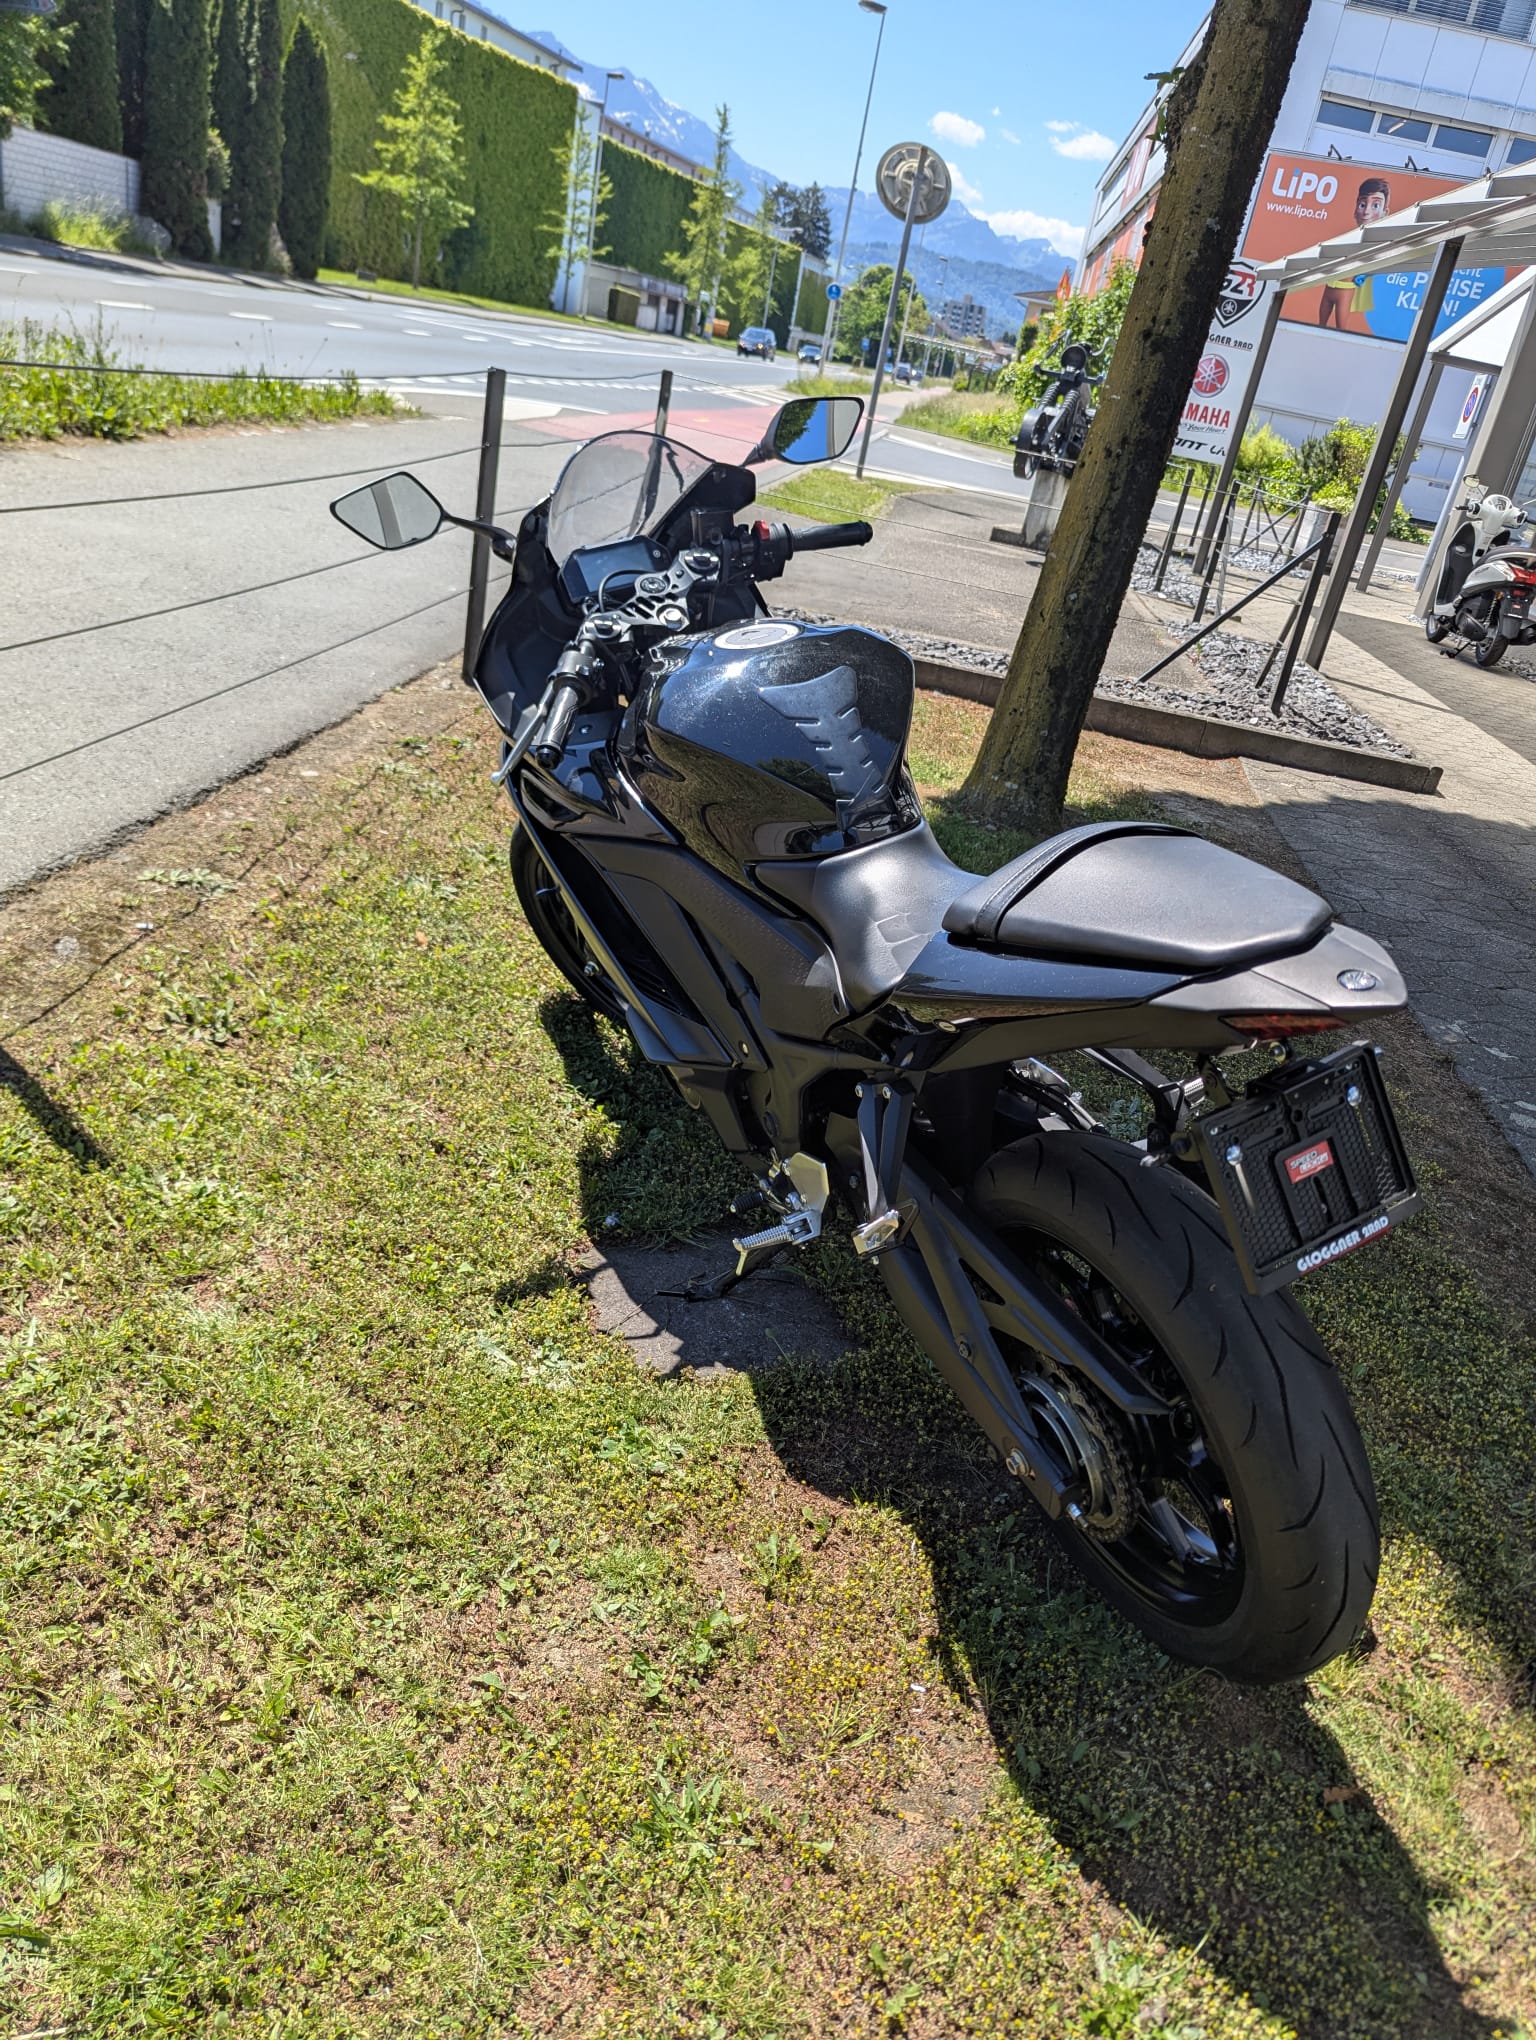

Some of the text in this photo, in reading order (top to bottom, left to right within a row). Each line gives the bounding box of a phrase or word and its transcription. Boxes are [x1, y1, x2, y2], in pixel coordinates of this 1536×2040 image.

[1266, 202, 1328, 220] www.lipo.ch
[1386, 272, 1485, 299] die PISE
[1396, 291, 1460, 317] KLN!
[1208, 334, 1254, 350] GNER 2RAD
[1181, 403, 1230, 428] MAHA
[1296, 1216, 1389, 1271] GLOGGNER 2RAD
